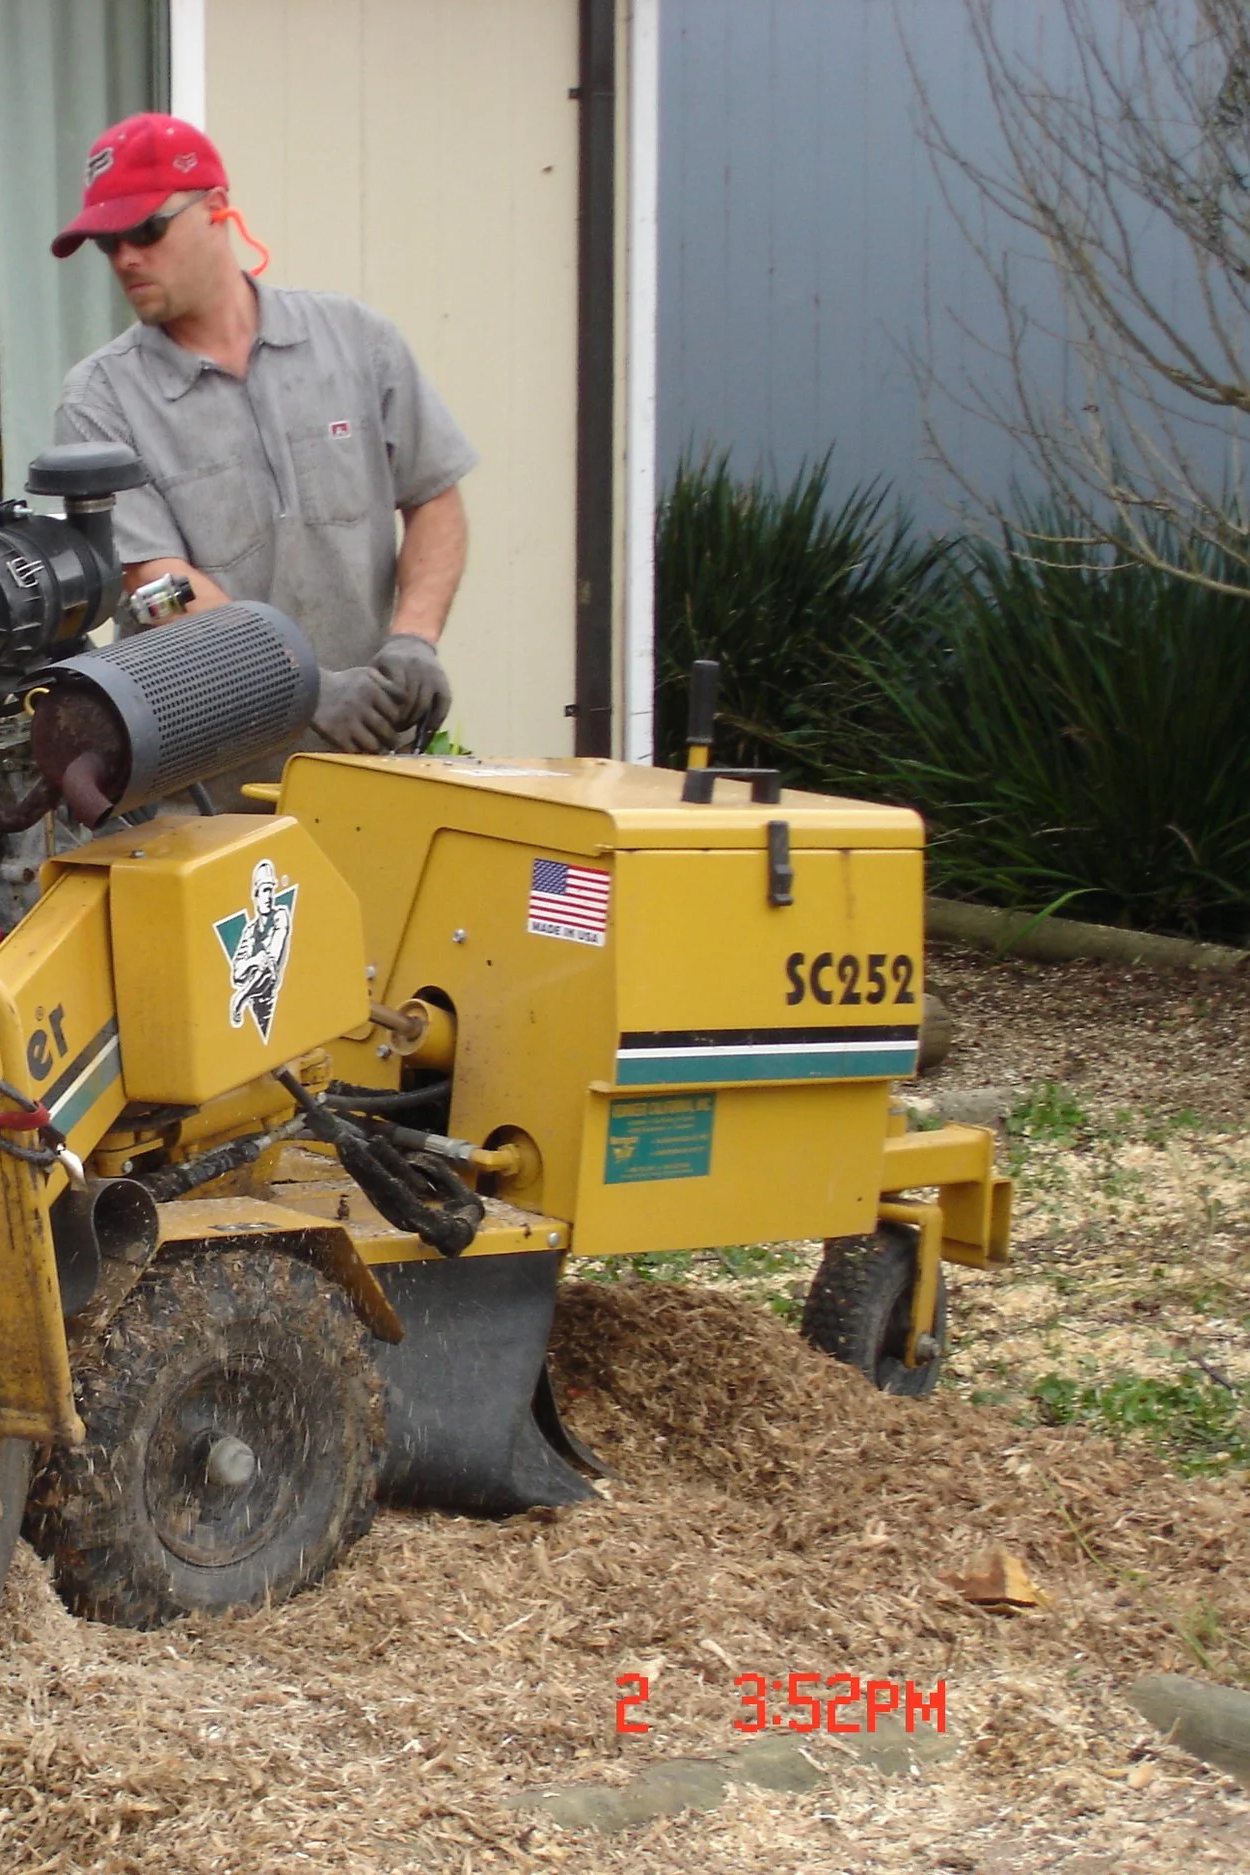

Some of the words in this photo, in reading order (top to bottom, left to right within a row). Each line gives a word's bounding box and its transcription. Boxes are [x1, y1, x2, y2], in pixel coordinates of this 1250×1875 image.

[532, 921, 561, 935] MADE
[563, 927, 576, 938] IN
[578, 930, 599, 944] USA
[784, 951, 916, 1006] SC252
